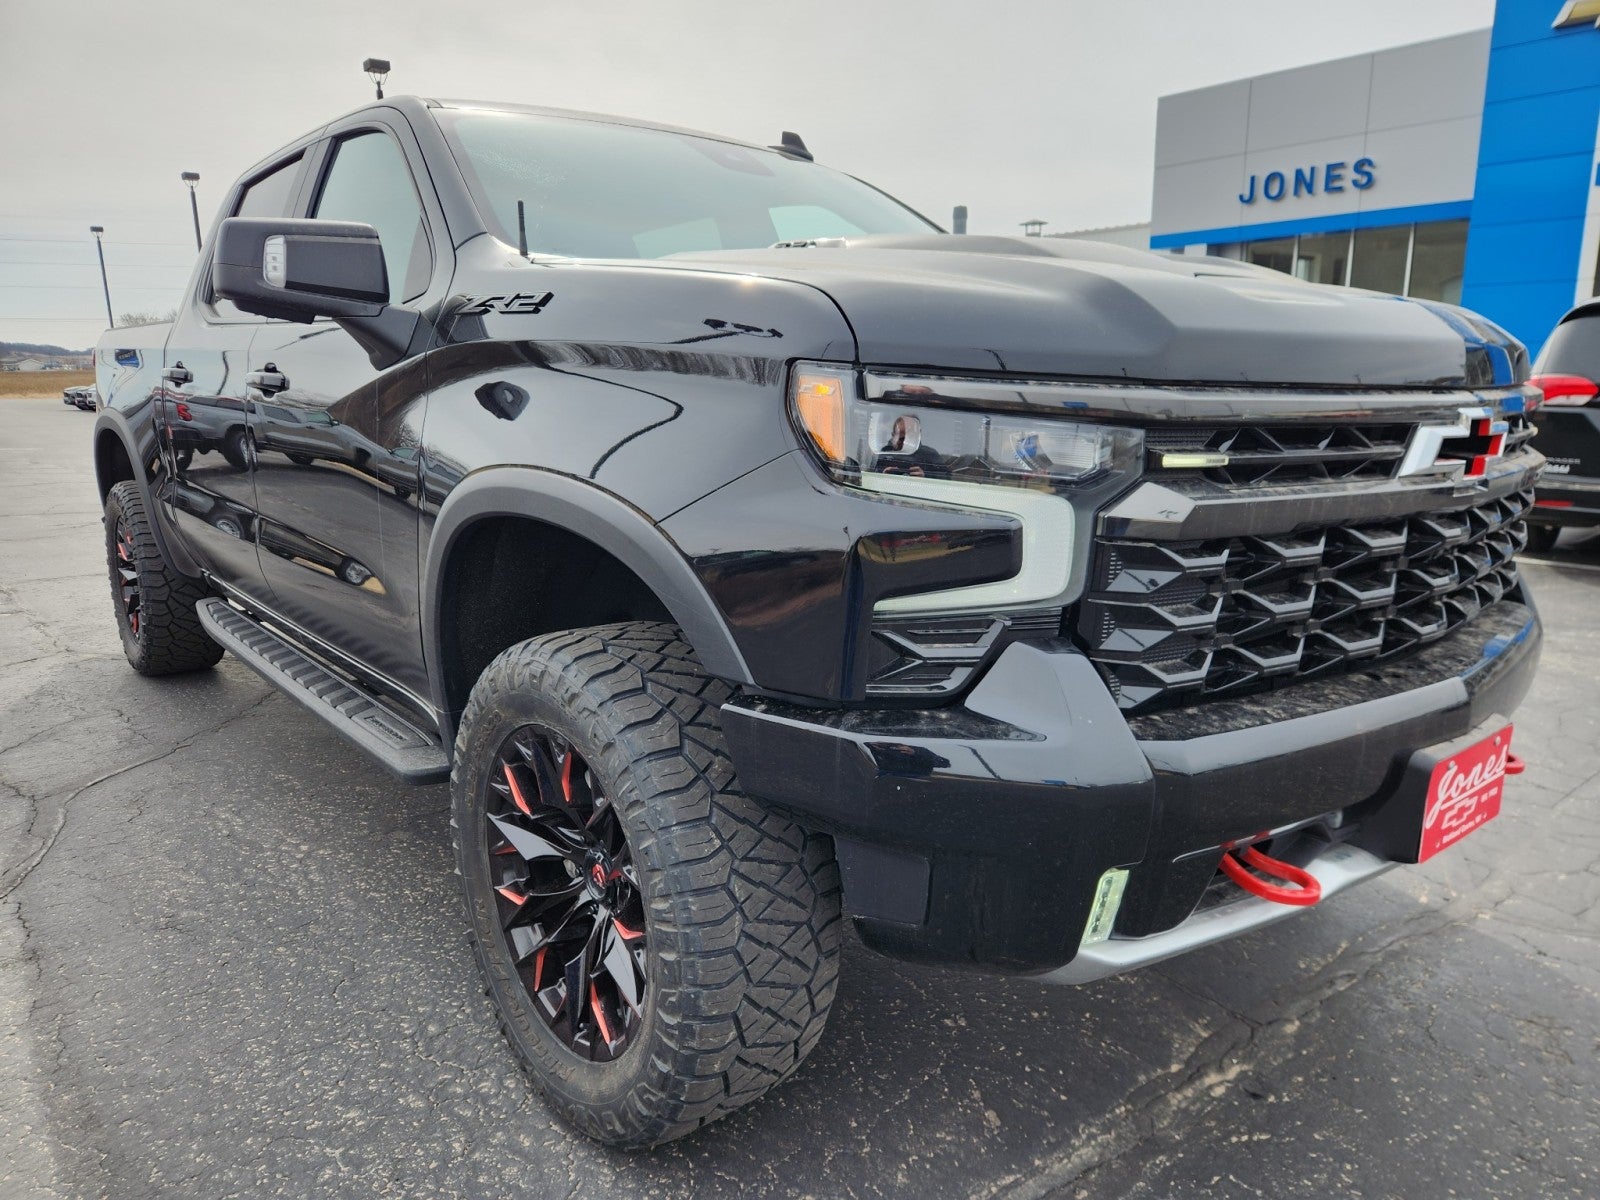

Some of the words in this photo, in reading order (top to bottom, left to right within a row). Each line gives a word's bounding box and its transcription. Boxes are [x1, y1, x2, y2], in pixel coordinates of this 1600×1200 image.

[1239, 157, 1377, 206] JONES
[454, 291, 555, 315] ZR2
[1424, 744, 1508, 829] Jones
